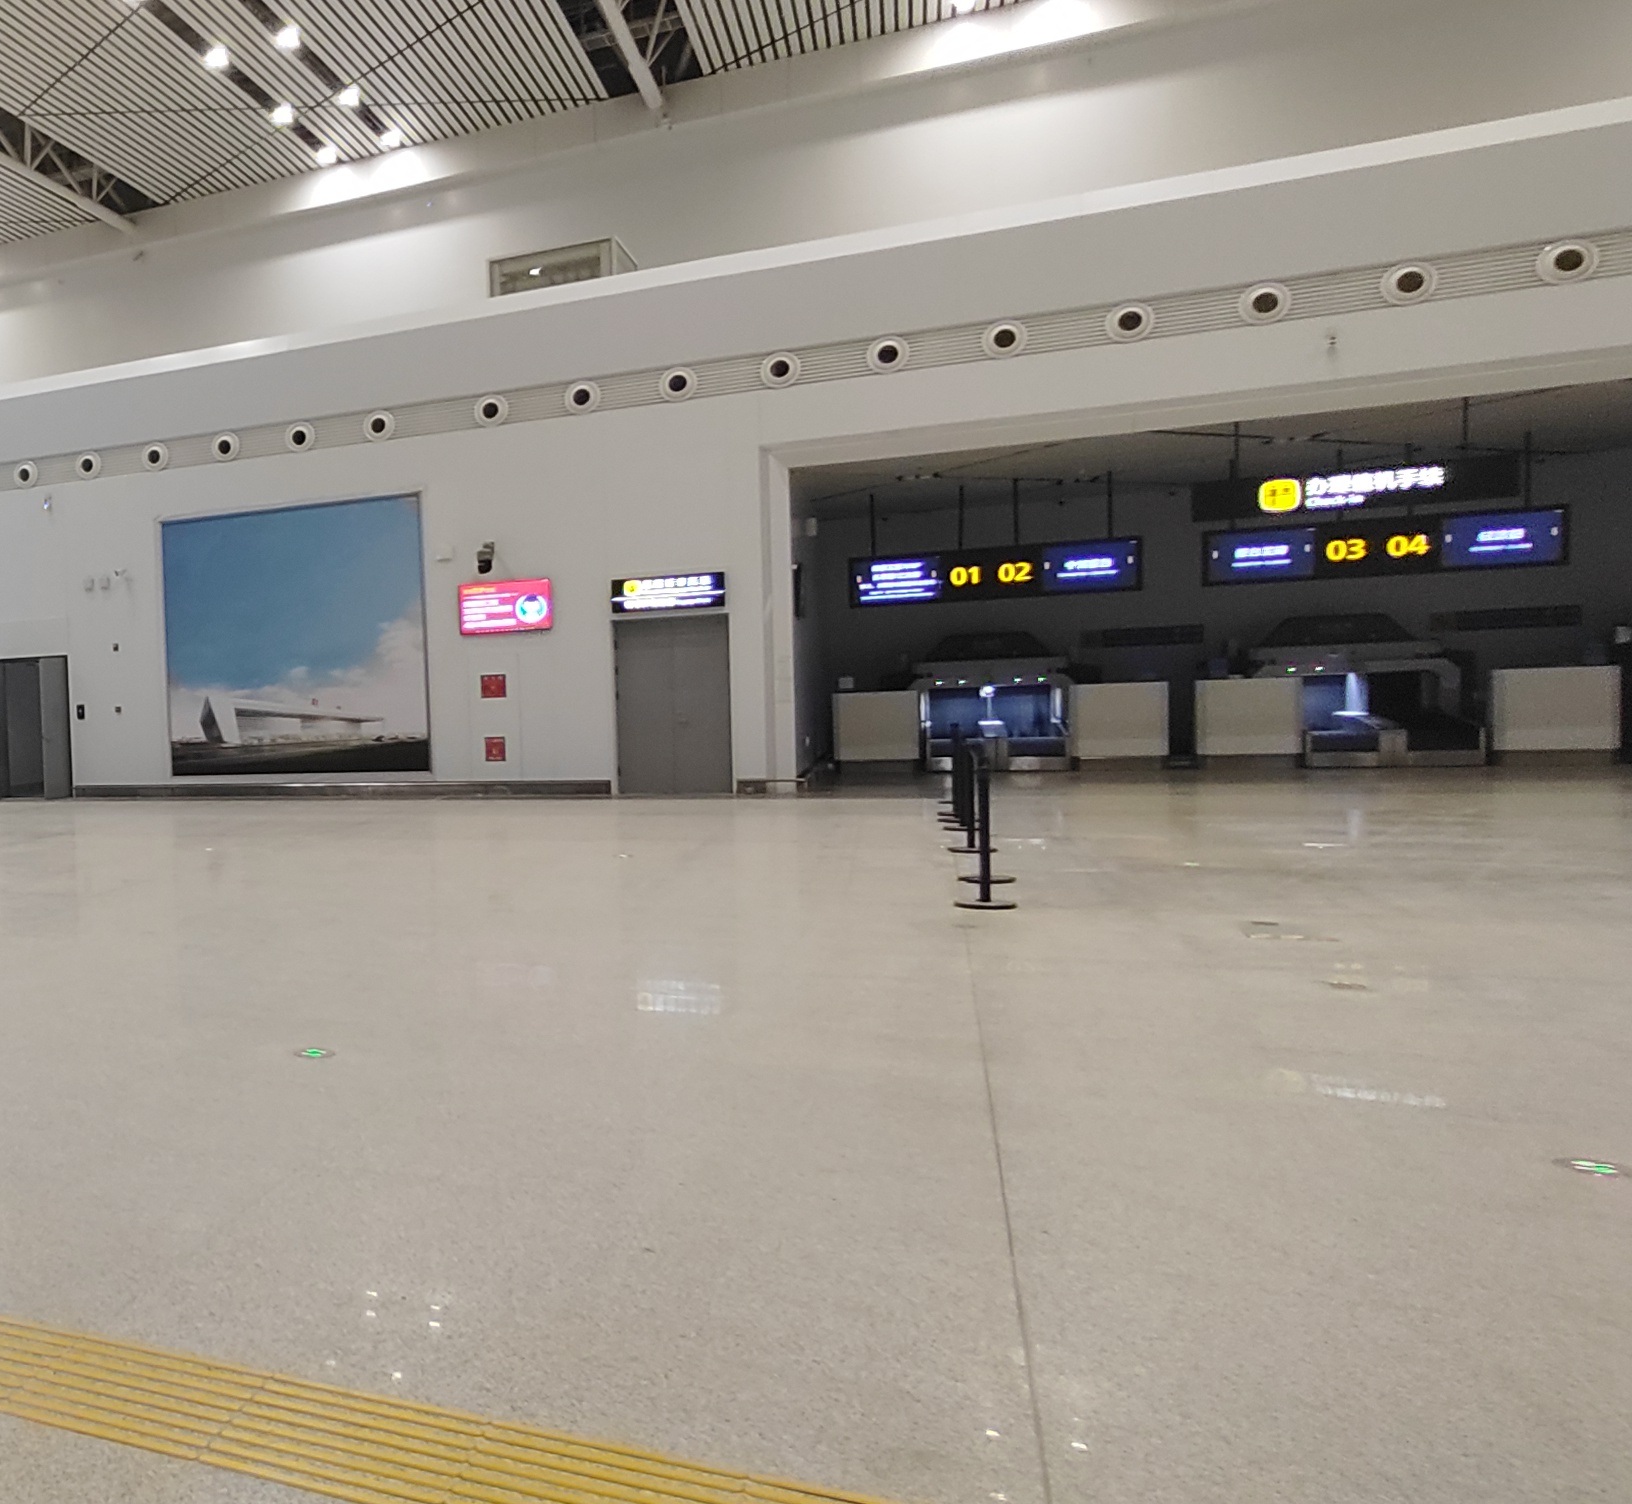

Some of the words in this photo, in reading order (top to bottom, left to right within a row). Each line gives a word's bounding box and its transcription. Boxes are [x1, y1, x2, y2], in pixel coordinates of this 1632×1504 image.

[1325, 538, 1368, 562] 03
[1385, 534, 1430, 558] 04
[949, 566, 982, 587] 01
[998, 562, 1033, 583] 02
